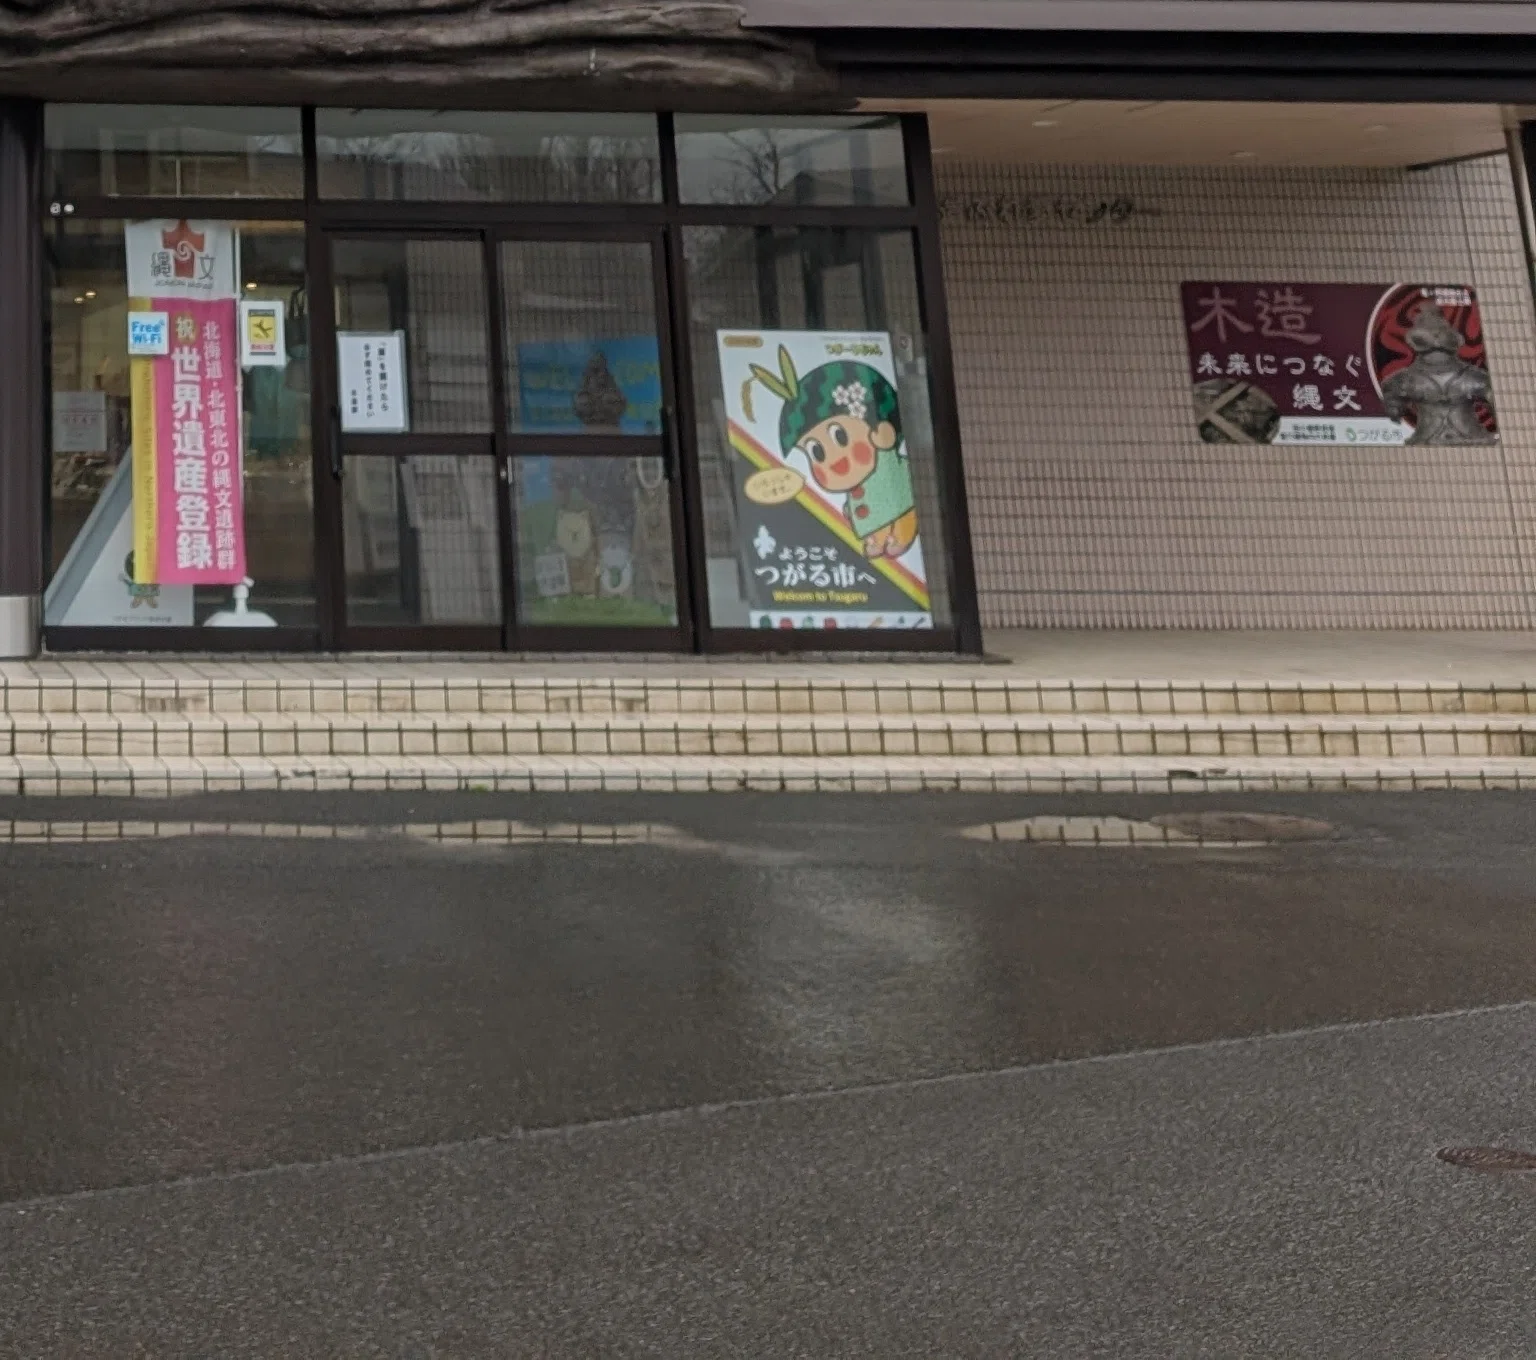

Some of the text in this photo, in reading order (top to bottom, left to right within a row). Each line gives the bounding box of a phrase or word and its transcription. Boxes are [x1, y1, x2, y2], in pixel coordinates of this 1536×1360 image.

[198, 252, 217, 280] 文
[131, 320, 162, 333] Free
[175, 316, 197, 340] 祝
[1191, 286, 1322, 345] 木造
[133, 333, 162, 344] Wi-Fi
[1196, 352, 1362, 378] 未来につなぐ
[1292, 383, 1362, 411] 縄文
[171, 345, 213, 570] 世界遺産登録
[778, 546, 838, 561] ようこそ
[755, 562, 877, 588] つがる市へ
